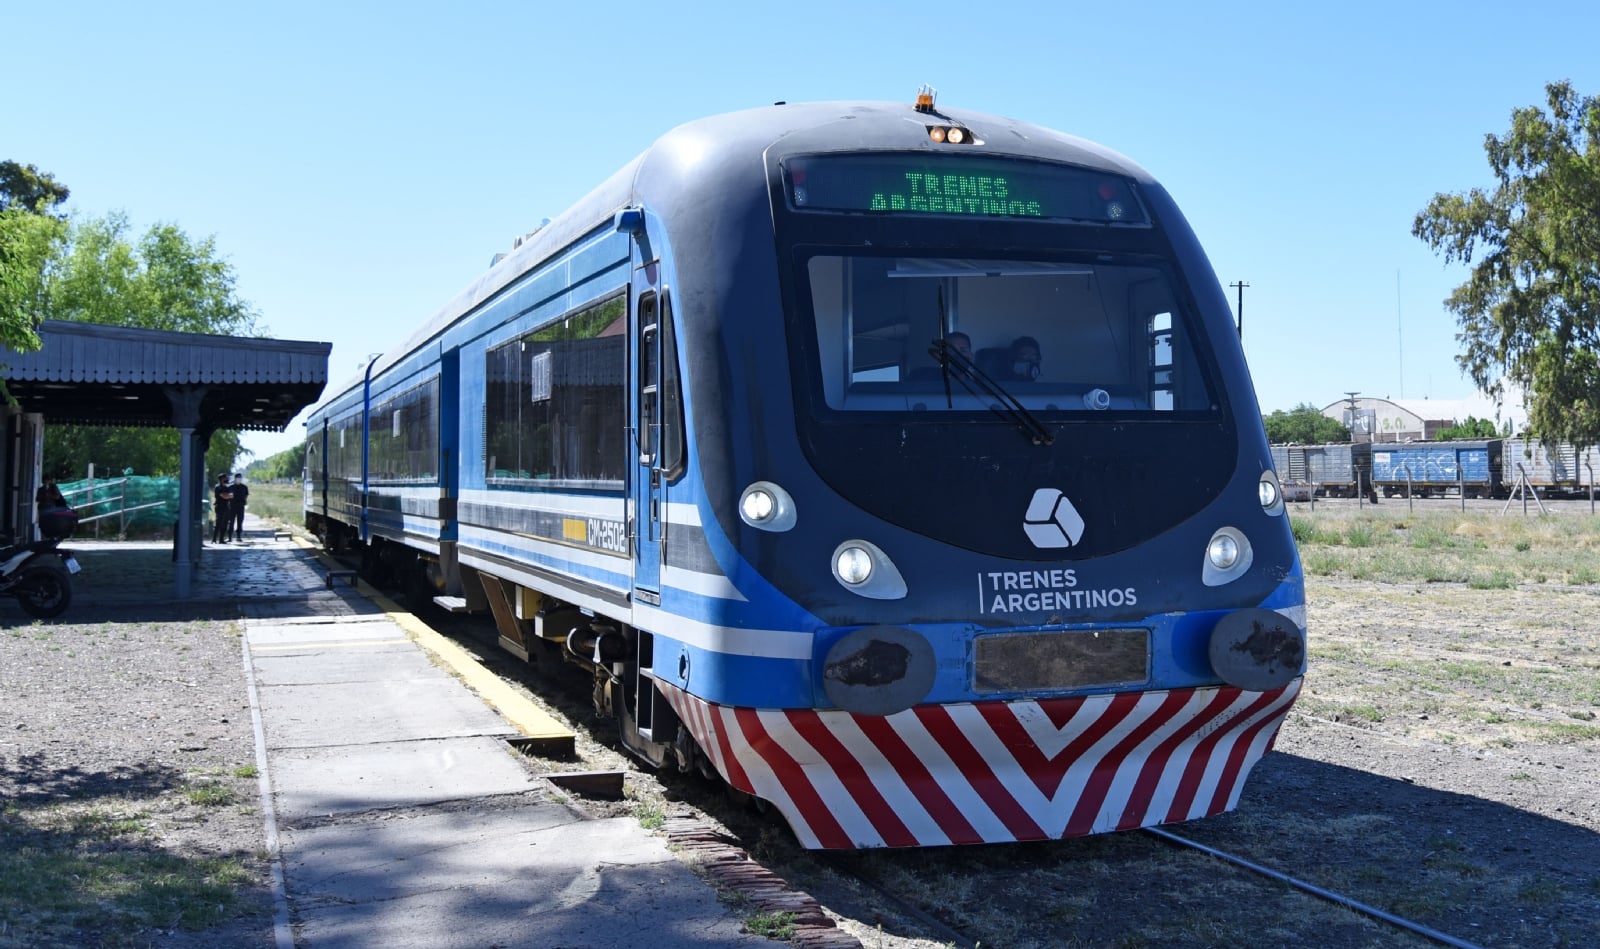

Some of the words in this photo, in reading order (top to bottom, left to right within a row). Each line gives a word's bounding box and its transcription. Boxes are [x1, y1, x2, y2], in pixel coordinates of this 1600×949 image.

[905, 172, 1008, 198] TRENES
[588, 518, 626, 553] CM-2502
[988, 569, 1077, 591] TRENES
[990, 587, 1137, 614] ARGENTINOS
